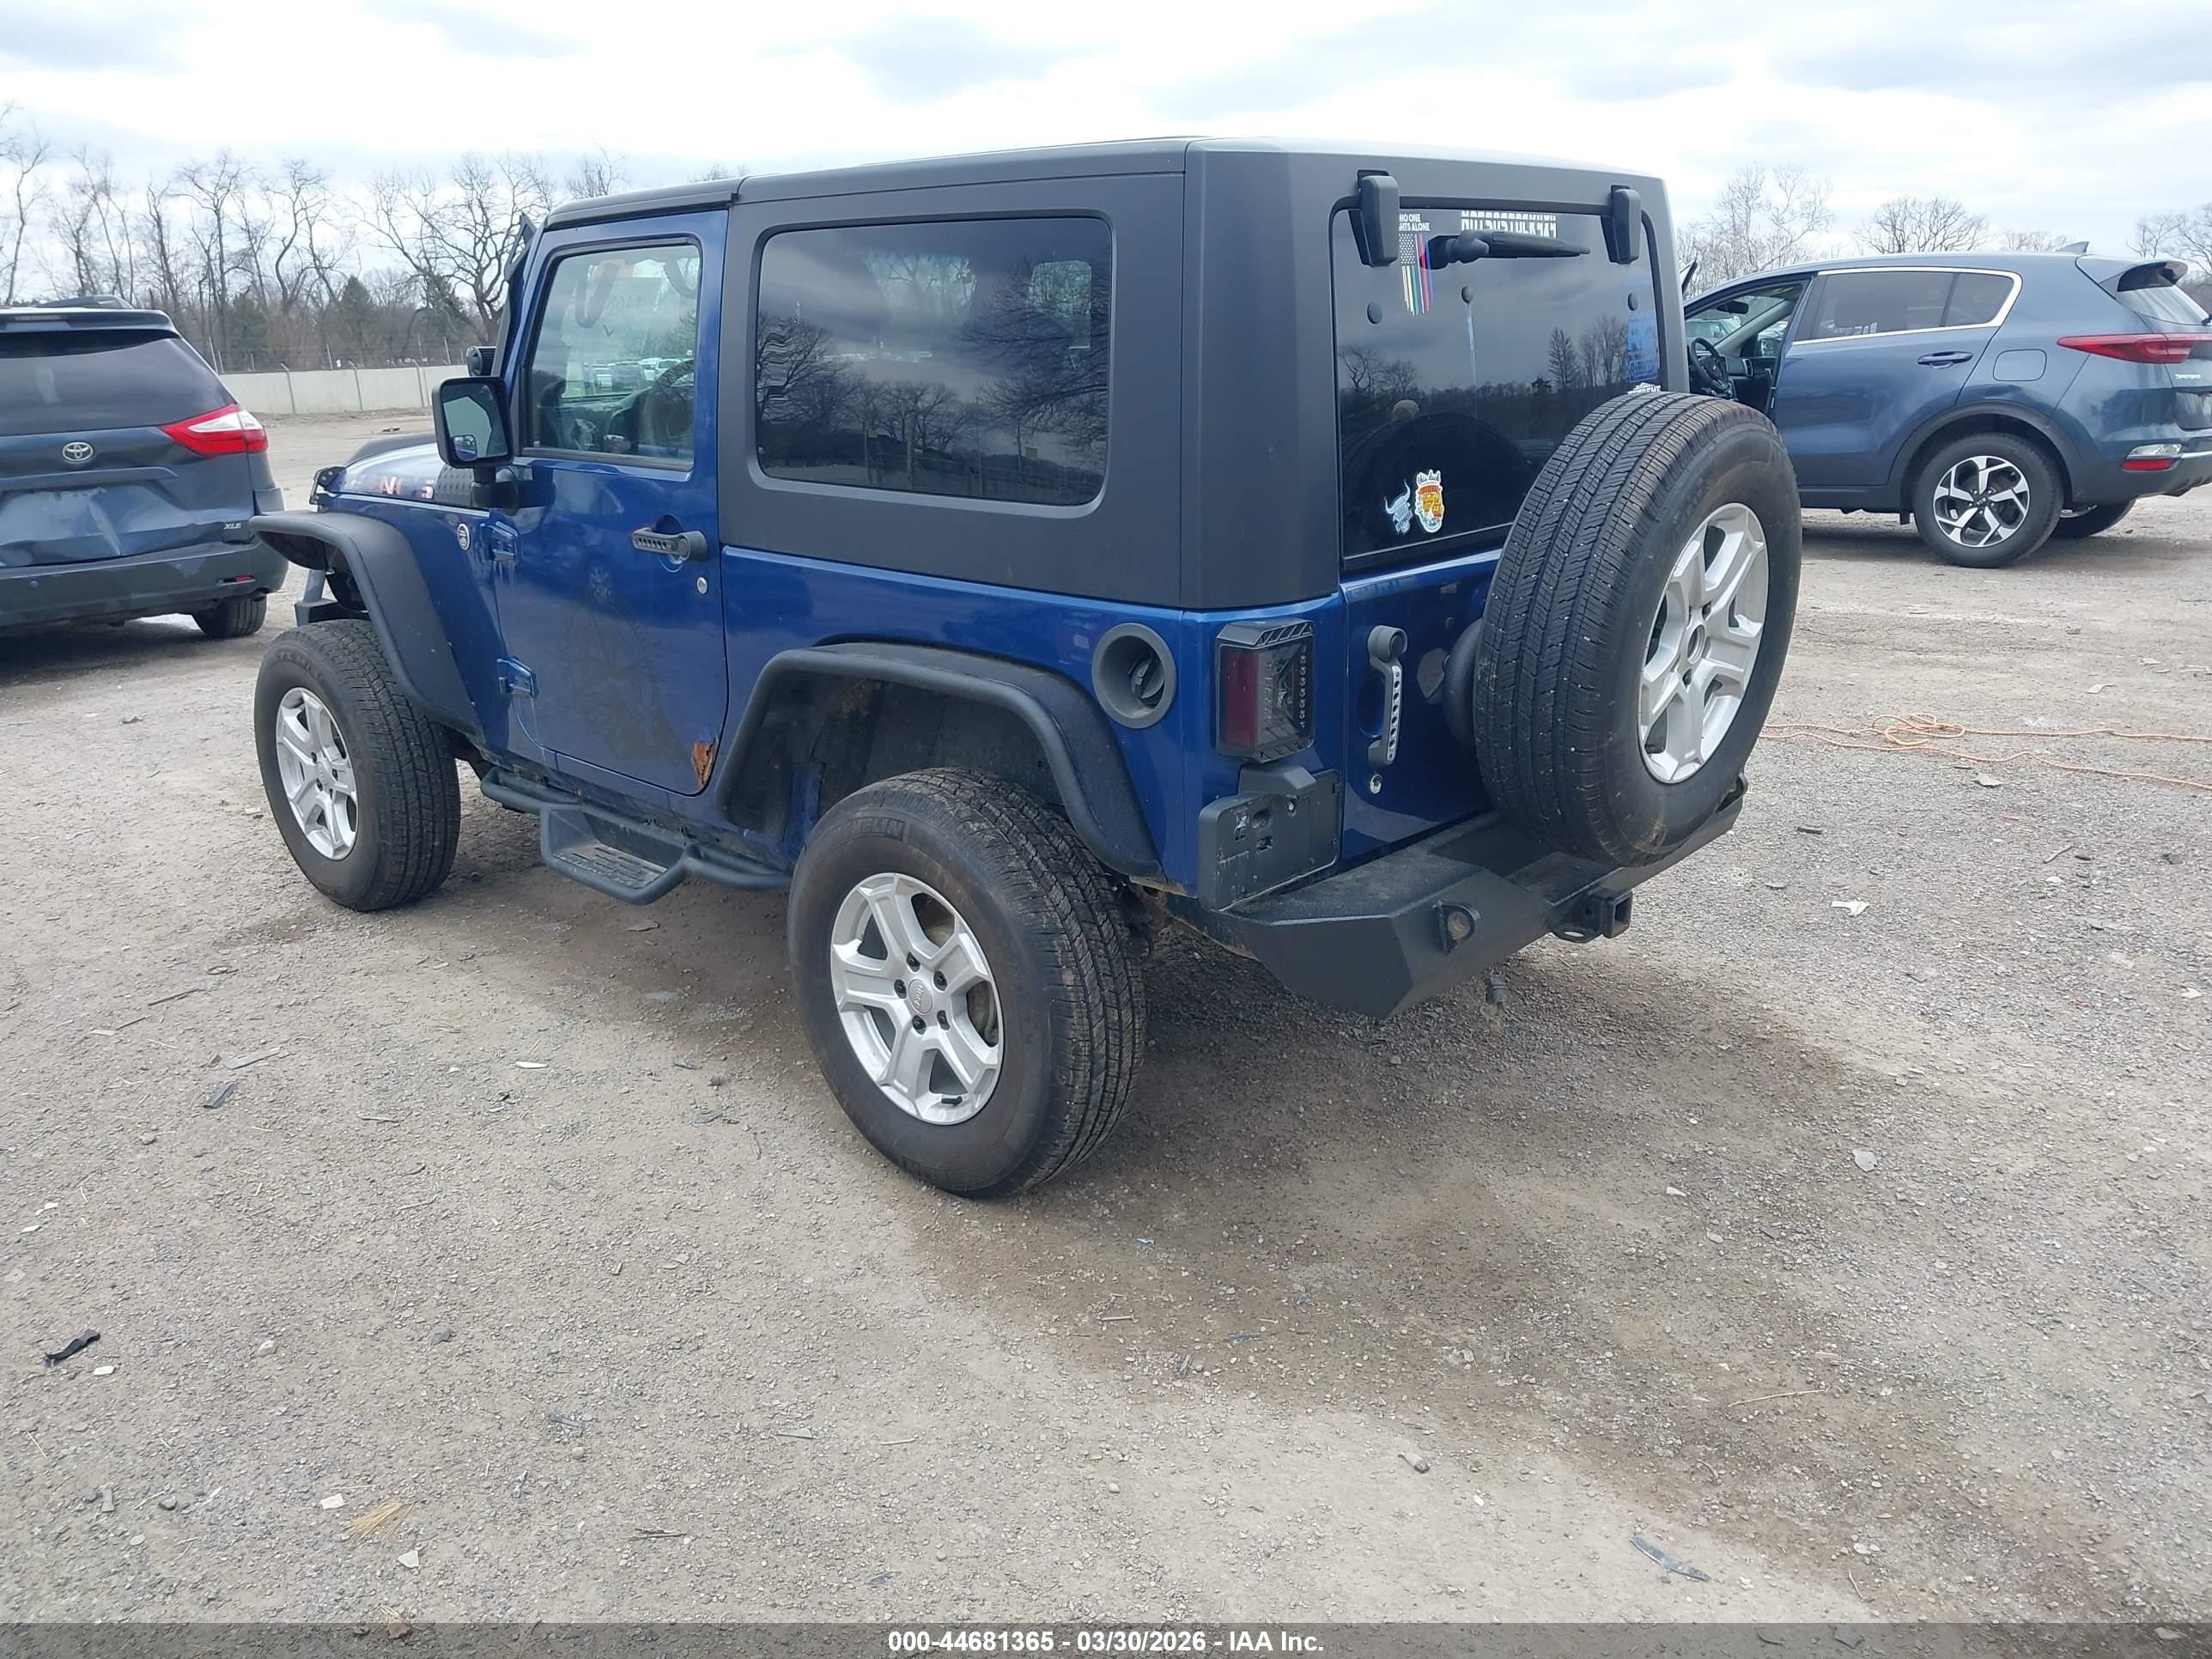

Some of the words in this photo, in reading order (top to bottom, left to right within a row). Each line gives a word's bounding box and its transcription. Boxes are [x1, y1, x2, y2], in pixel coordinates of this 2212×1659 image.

[1399, 213, 1408, 222] NO
[1408, 213, 1421, 222] ONE
[1411, 222, 1431, 232] ALONE
